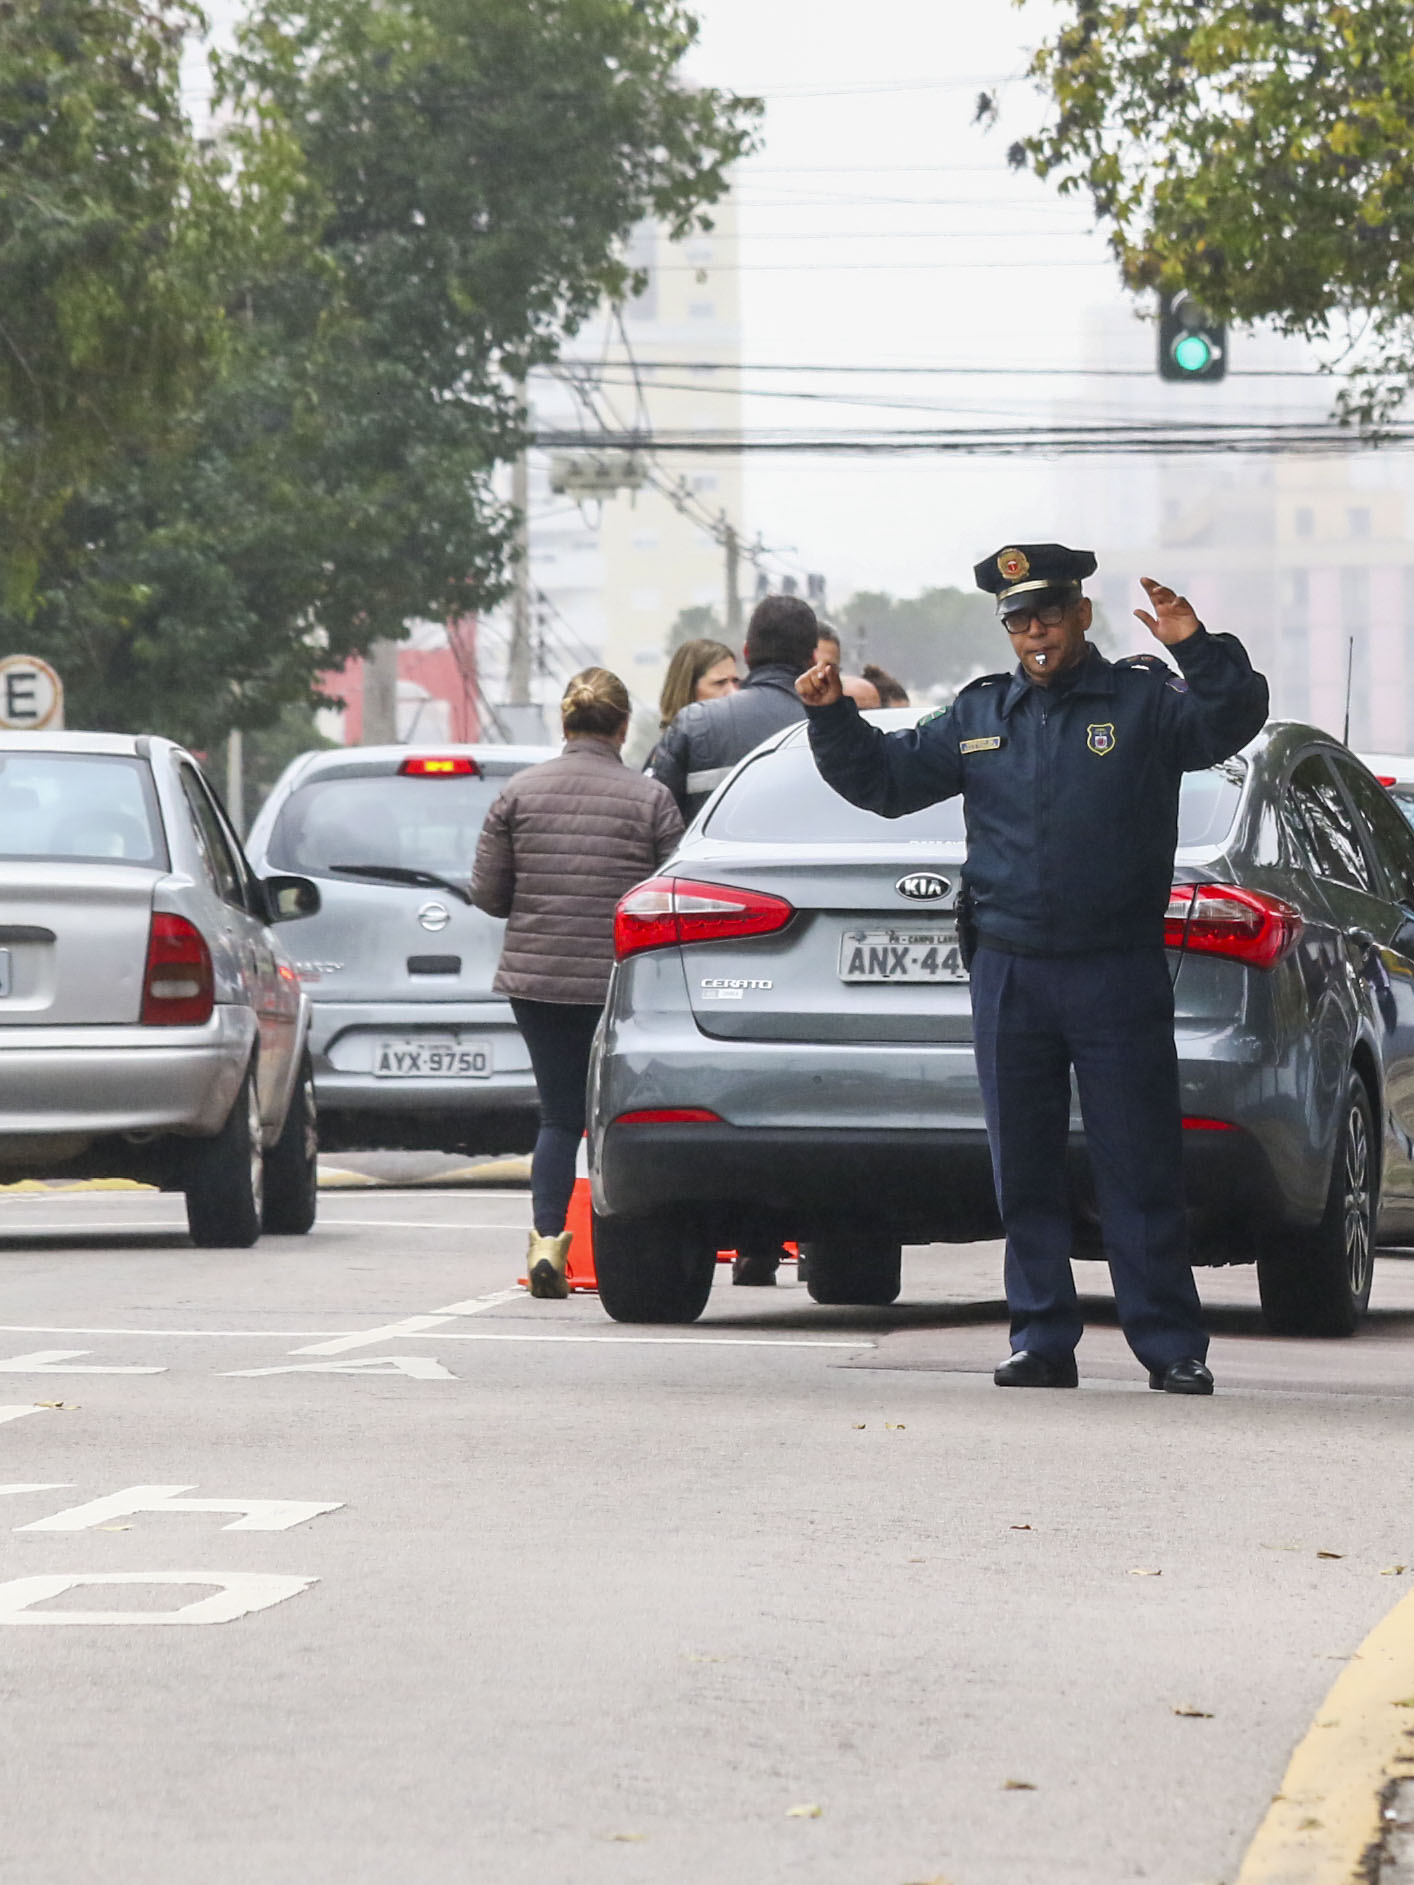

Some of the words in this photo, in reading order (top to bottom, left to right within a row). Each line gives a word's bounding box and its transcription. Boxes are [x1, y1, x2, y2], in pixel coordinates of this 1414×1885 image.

[7, 673, 37, 718] E
[904, 878, 942, 896] KIA
[701, 978, 774, 990] CERATO
[379, 1052, 486, 1072] AYX-9750
